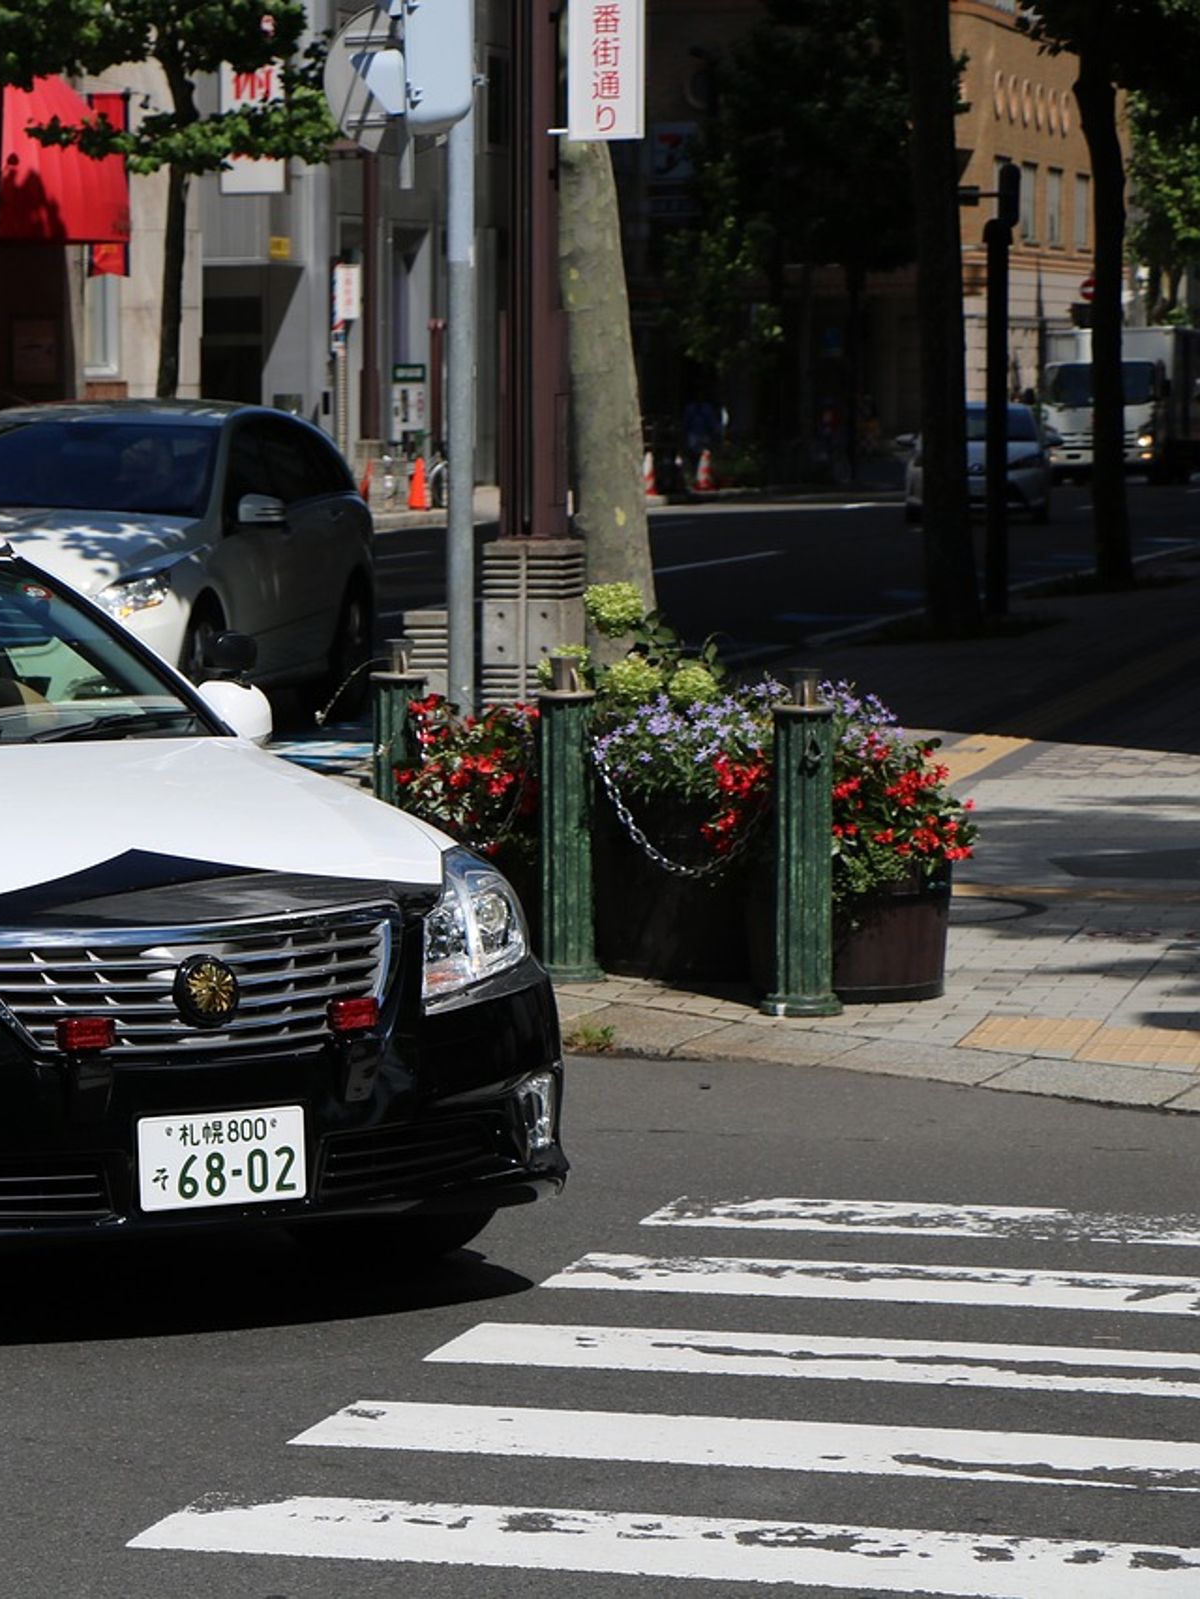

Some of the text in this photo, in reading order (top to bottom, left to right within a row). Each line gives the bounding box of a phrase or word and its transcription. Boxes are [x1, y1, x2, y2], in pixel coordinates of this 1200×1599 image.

[591, 3, 621, 132] 番街通り
[177, 1145, 297, 1200] 68-02
